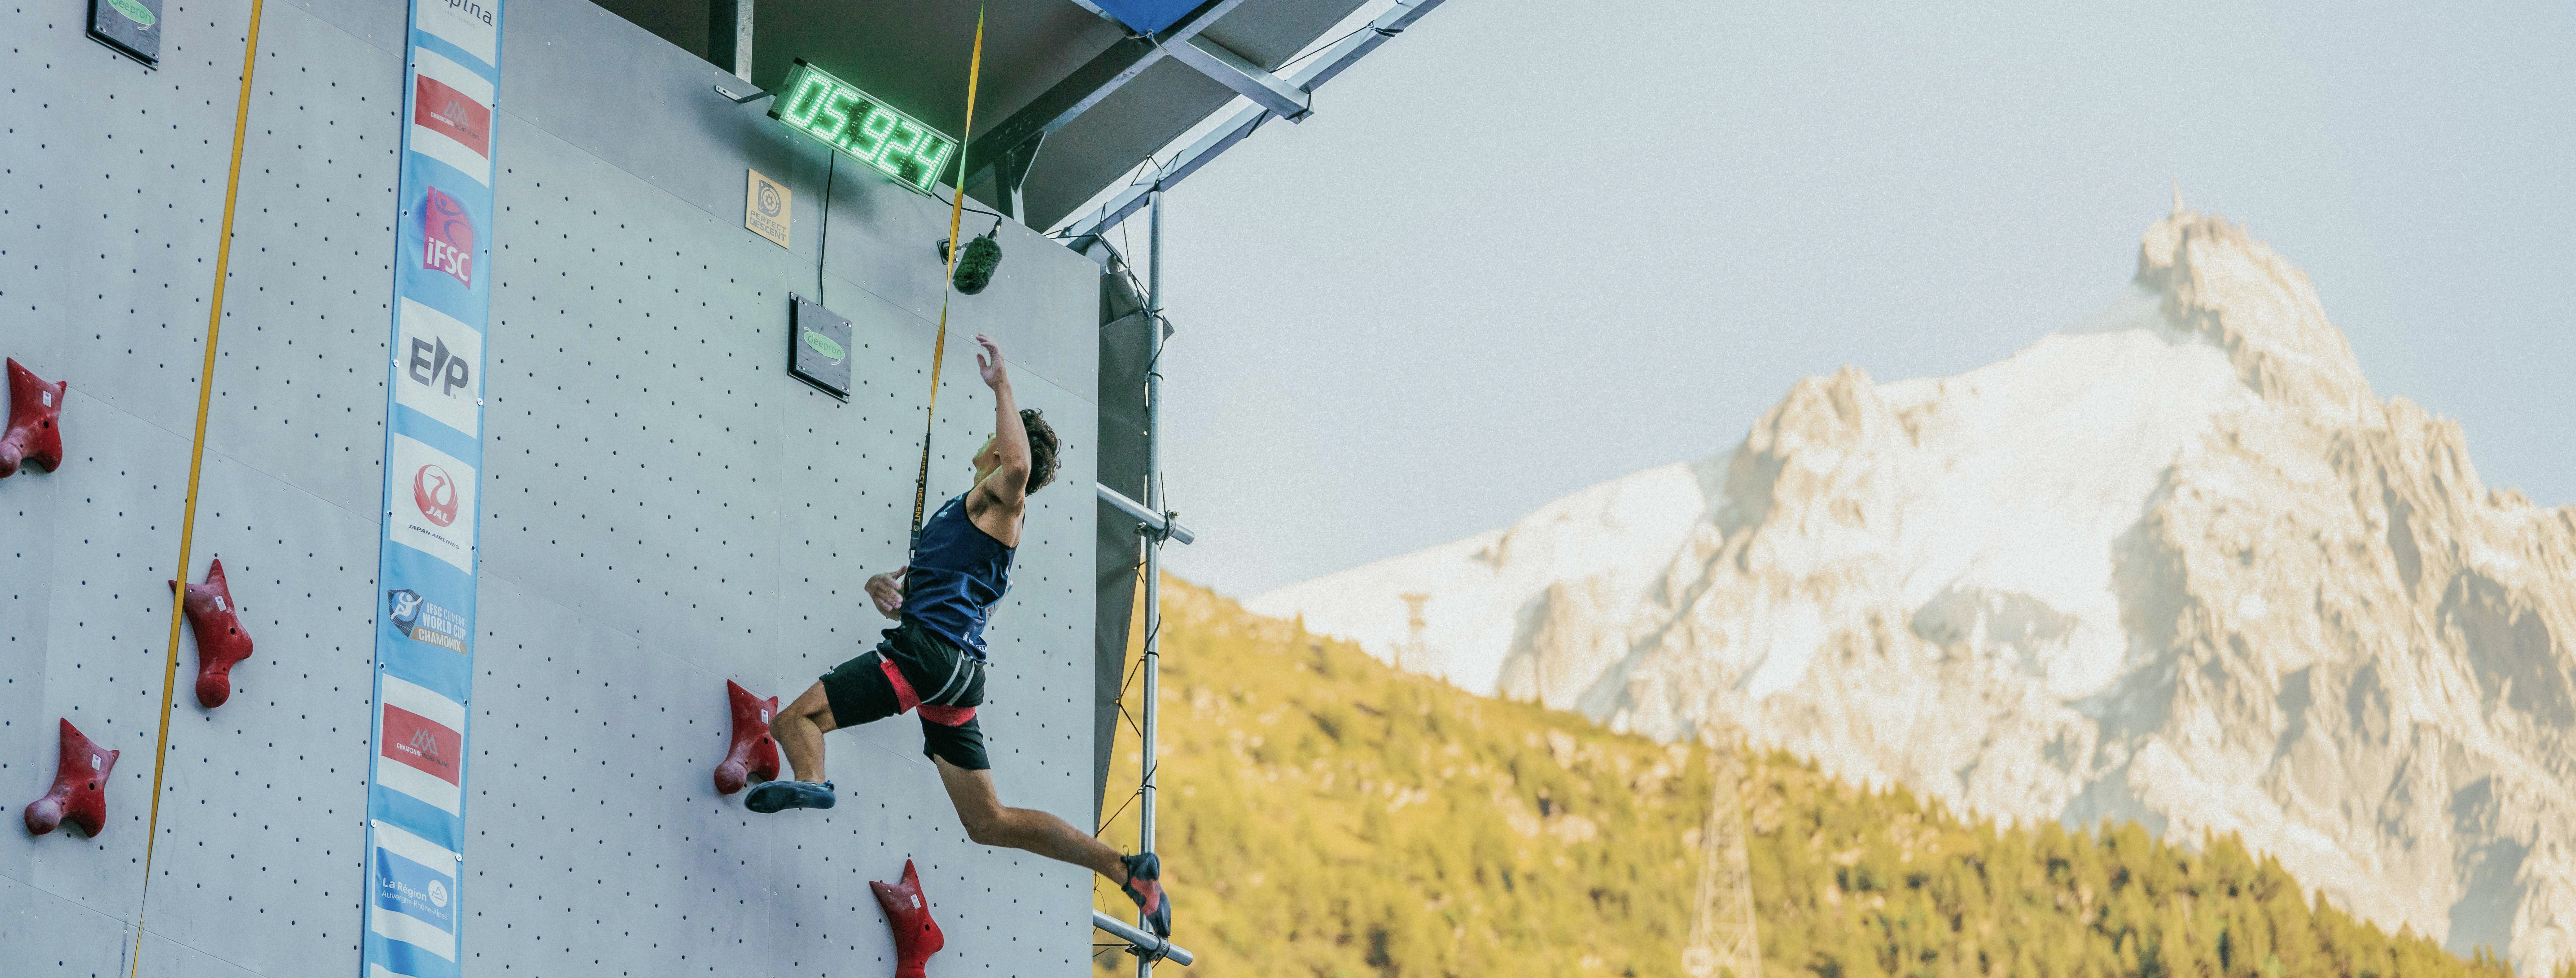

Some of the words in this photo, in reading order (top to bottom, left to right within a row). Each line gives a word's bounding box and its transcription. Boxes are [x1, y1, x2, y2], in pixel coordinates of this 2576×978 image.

[112, 0, 151, 28] eepron
[444, 0, 492, 27] pina
[786, 74, 949, 188] 05.924
[750, 210, 786, 233] PERFECT
[750, 217, 786, 241] DESCENT
[426, 506, 449, 523] JAL
[915, 487, 923, 522] DESCENT
[408, 524, 430, 535] JAPAN
[432, 532, 459, 549] AIRLINES
[422, 613, 451, 634] WORLD
[454, 624, 466, 640] CUP
[427, 602, 442, 617] IFSC
[444, 609, 466, 628] CLIMBING
[418, 628, 461, 653] CHAMONIX
[383, 877, 395, 889] La
[398, 881, 427, 901] Région
[382, 890, 447, 920] Auvergne-Rhône-Alpes
